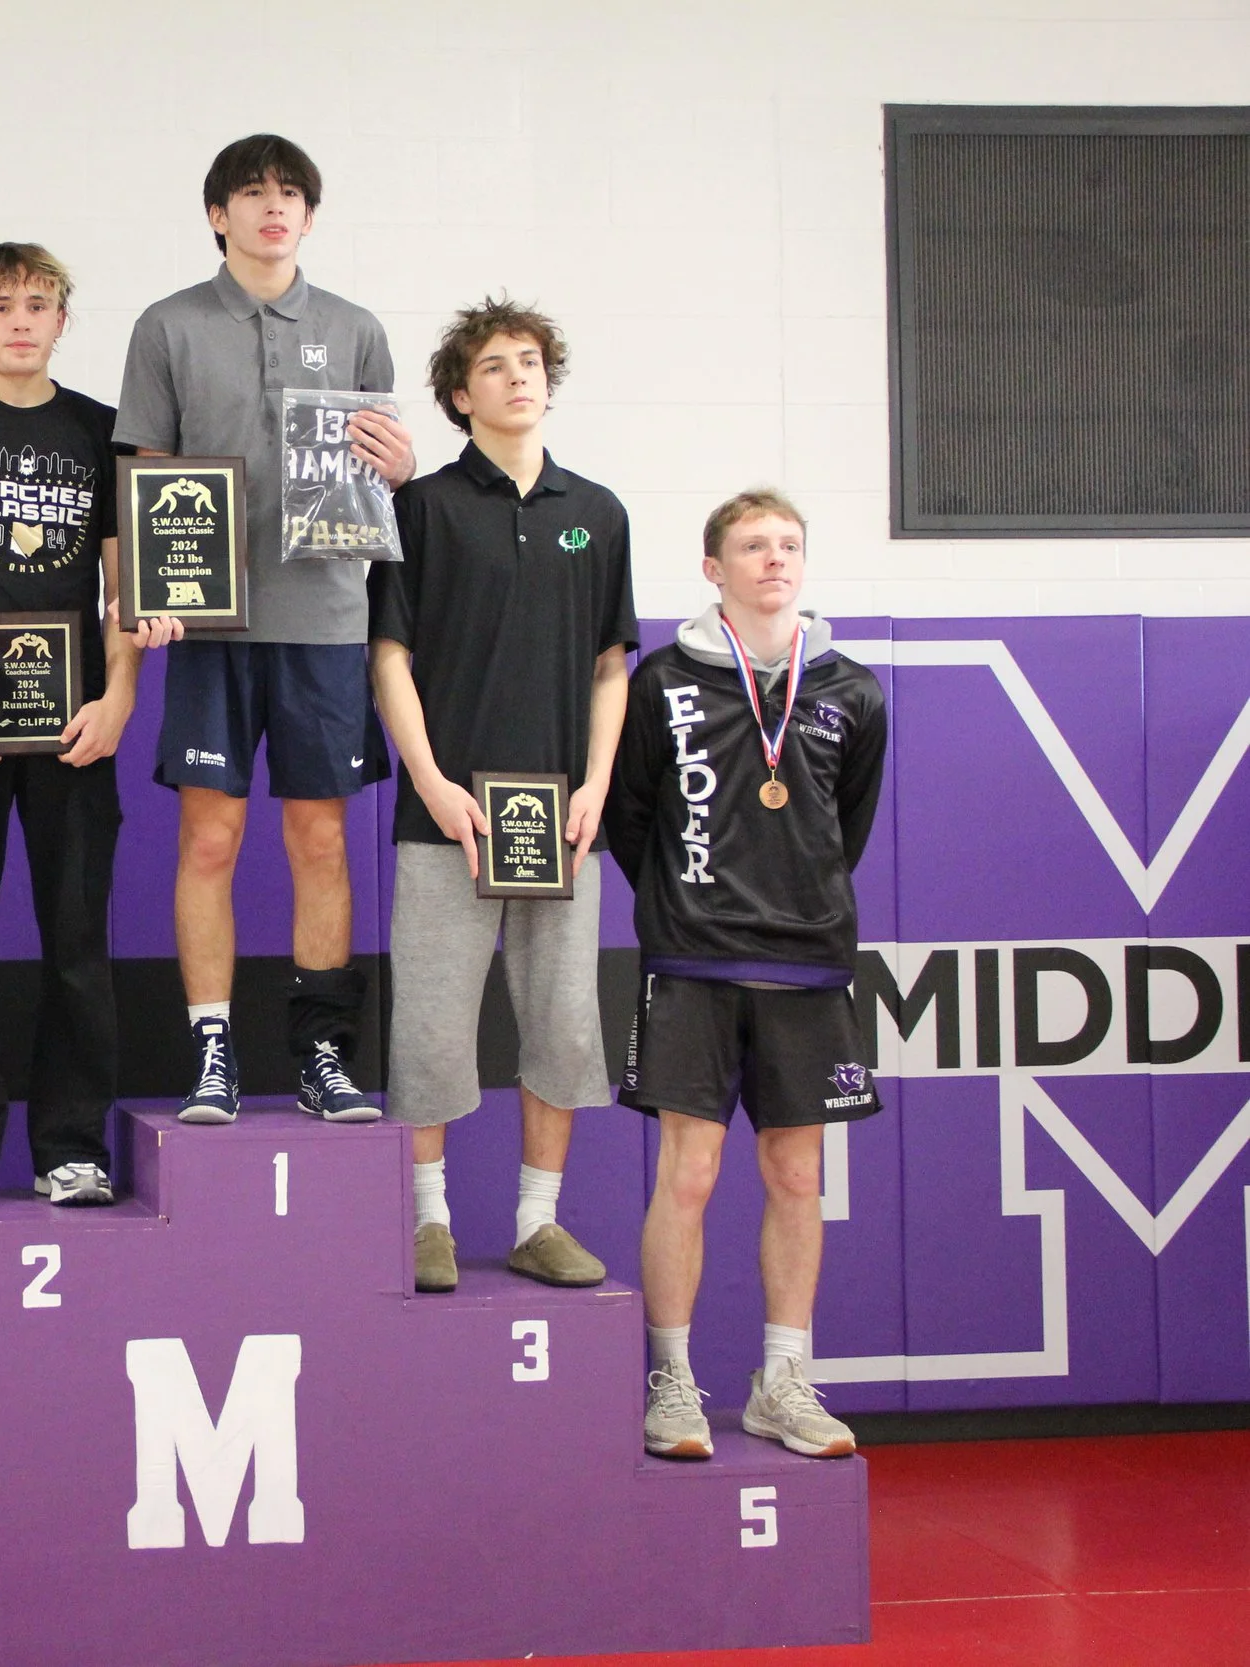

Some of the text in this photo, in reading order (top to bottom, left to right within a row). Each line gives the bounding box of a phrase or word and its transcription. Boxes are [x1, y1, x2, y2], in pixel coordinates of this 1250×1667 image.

[305, 349, 323, 364] M
[152, 517, 216, 527] S.W.O.W.C.A.
[153, 526, 215, 535] Coaches Classic
[46, 528, 67, 550] 24
[171, 540, 198, 551] 2024
[166, 554, 203, 564] 132 lbs
[8, 563, 45, 573] OHIO
[158, 566, 212, 577] Champion
[5, 668, 30, 676] Coaches
[17, 680, 39, 689] 2024
[12, 691, 45, 699] 132 lbs
[2, 700, 55, 711] Runner-Up
[18, 717, 62, 727] CLIFFS
[663, 683, 718, 884] ELDER
[501, 820, 546, 828] S.W.O.W.C.A.
[514, 836, 535, 844] 2024
[509, 846, 541, 856] 132 lbs
[503, 855, 547, 865] 3rd Place
[273, 1152, 289, 1216] 1
[22, 1244, 62, 1309] 2
[512, 1319, 550, 1383] 3
[126, 1334, 305, 1549] M
[740, 1486, 778, 1549] 5
